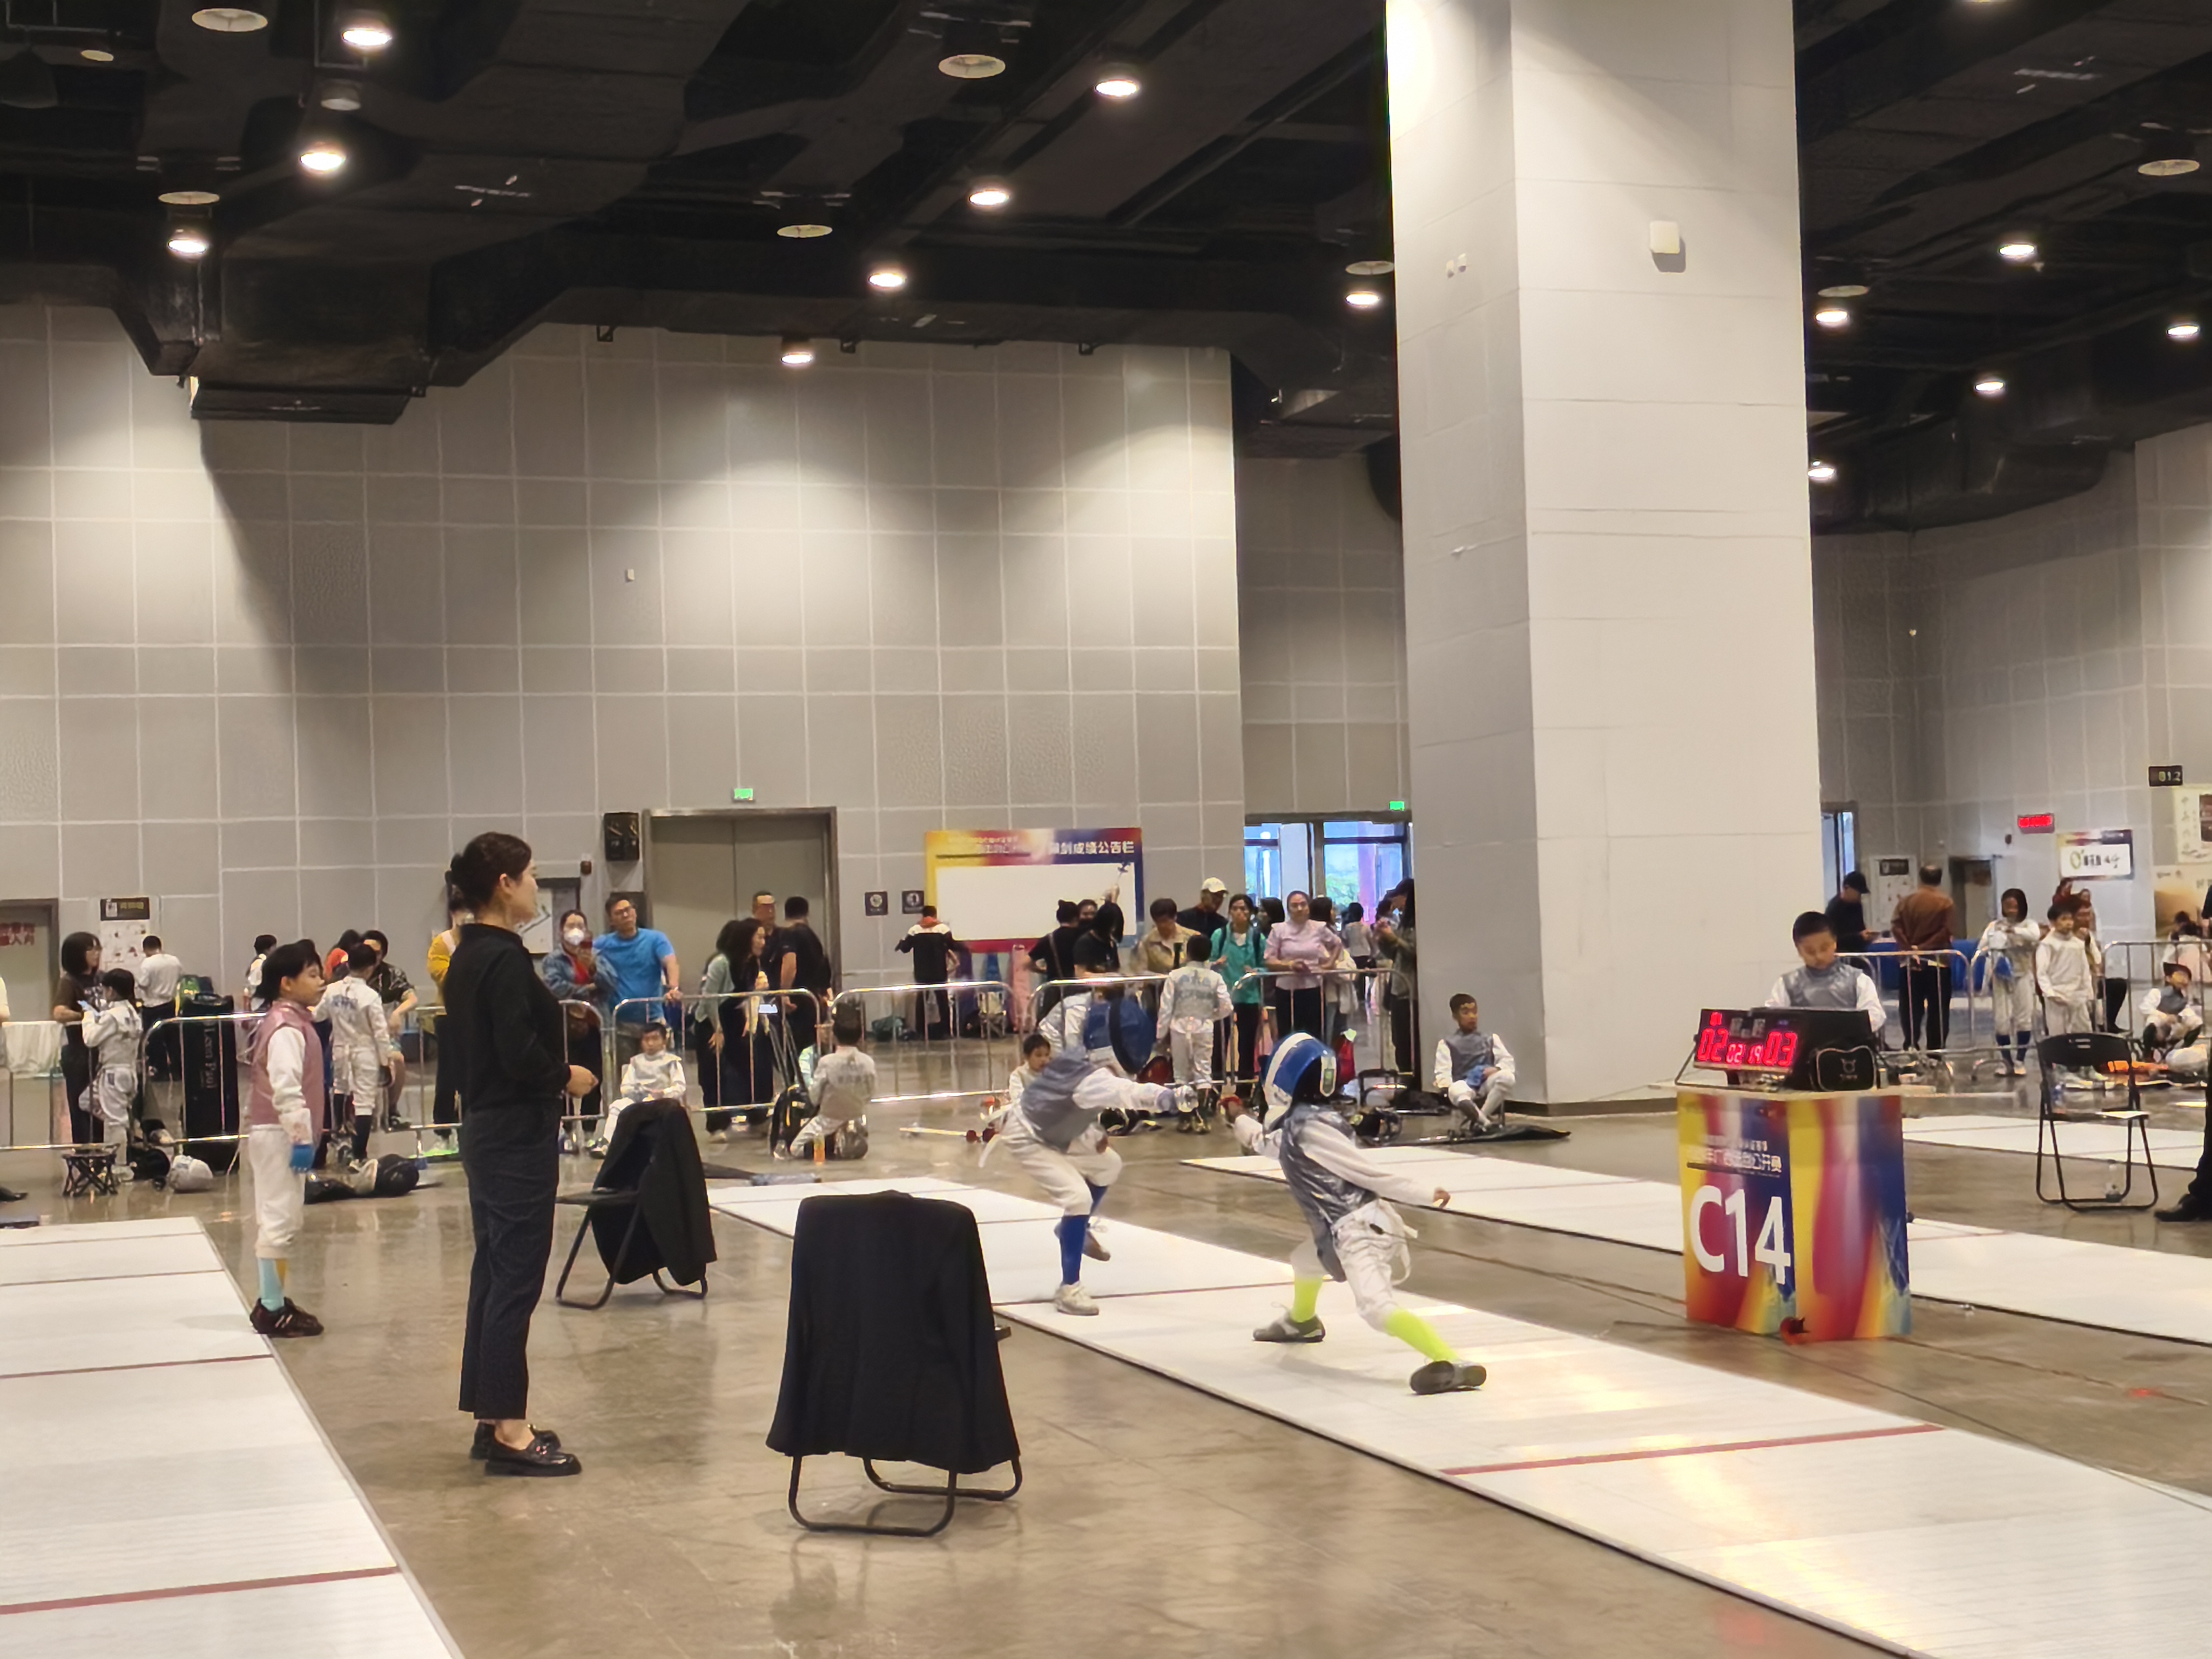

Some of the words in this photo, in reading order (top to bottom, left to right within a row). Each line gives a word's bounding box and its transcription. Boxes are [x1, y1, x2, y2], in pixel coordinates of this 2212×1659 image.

[1697, 1028, 1728, 1061] 02
[1763, 1031, 1798, 1066] 03
[1690, 1185, 1791, 1285] C14
